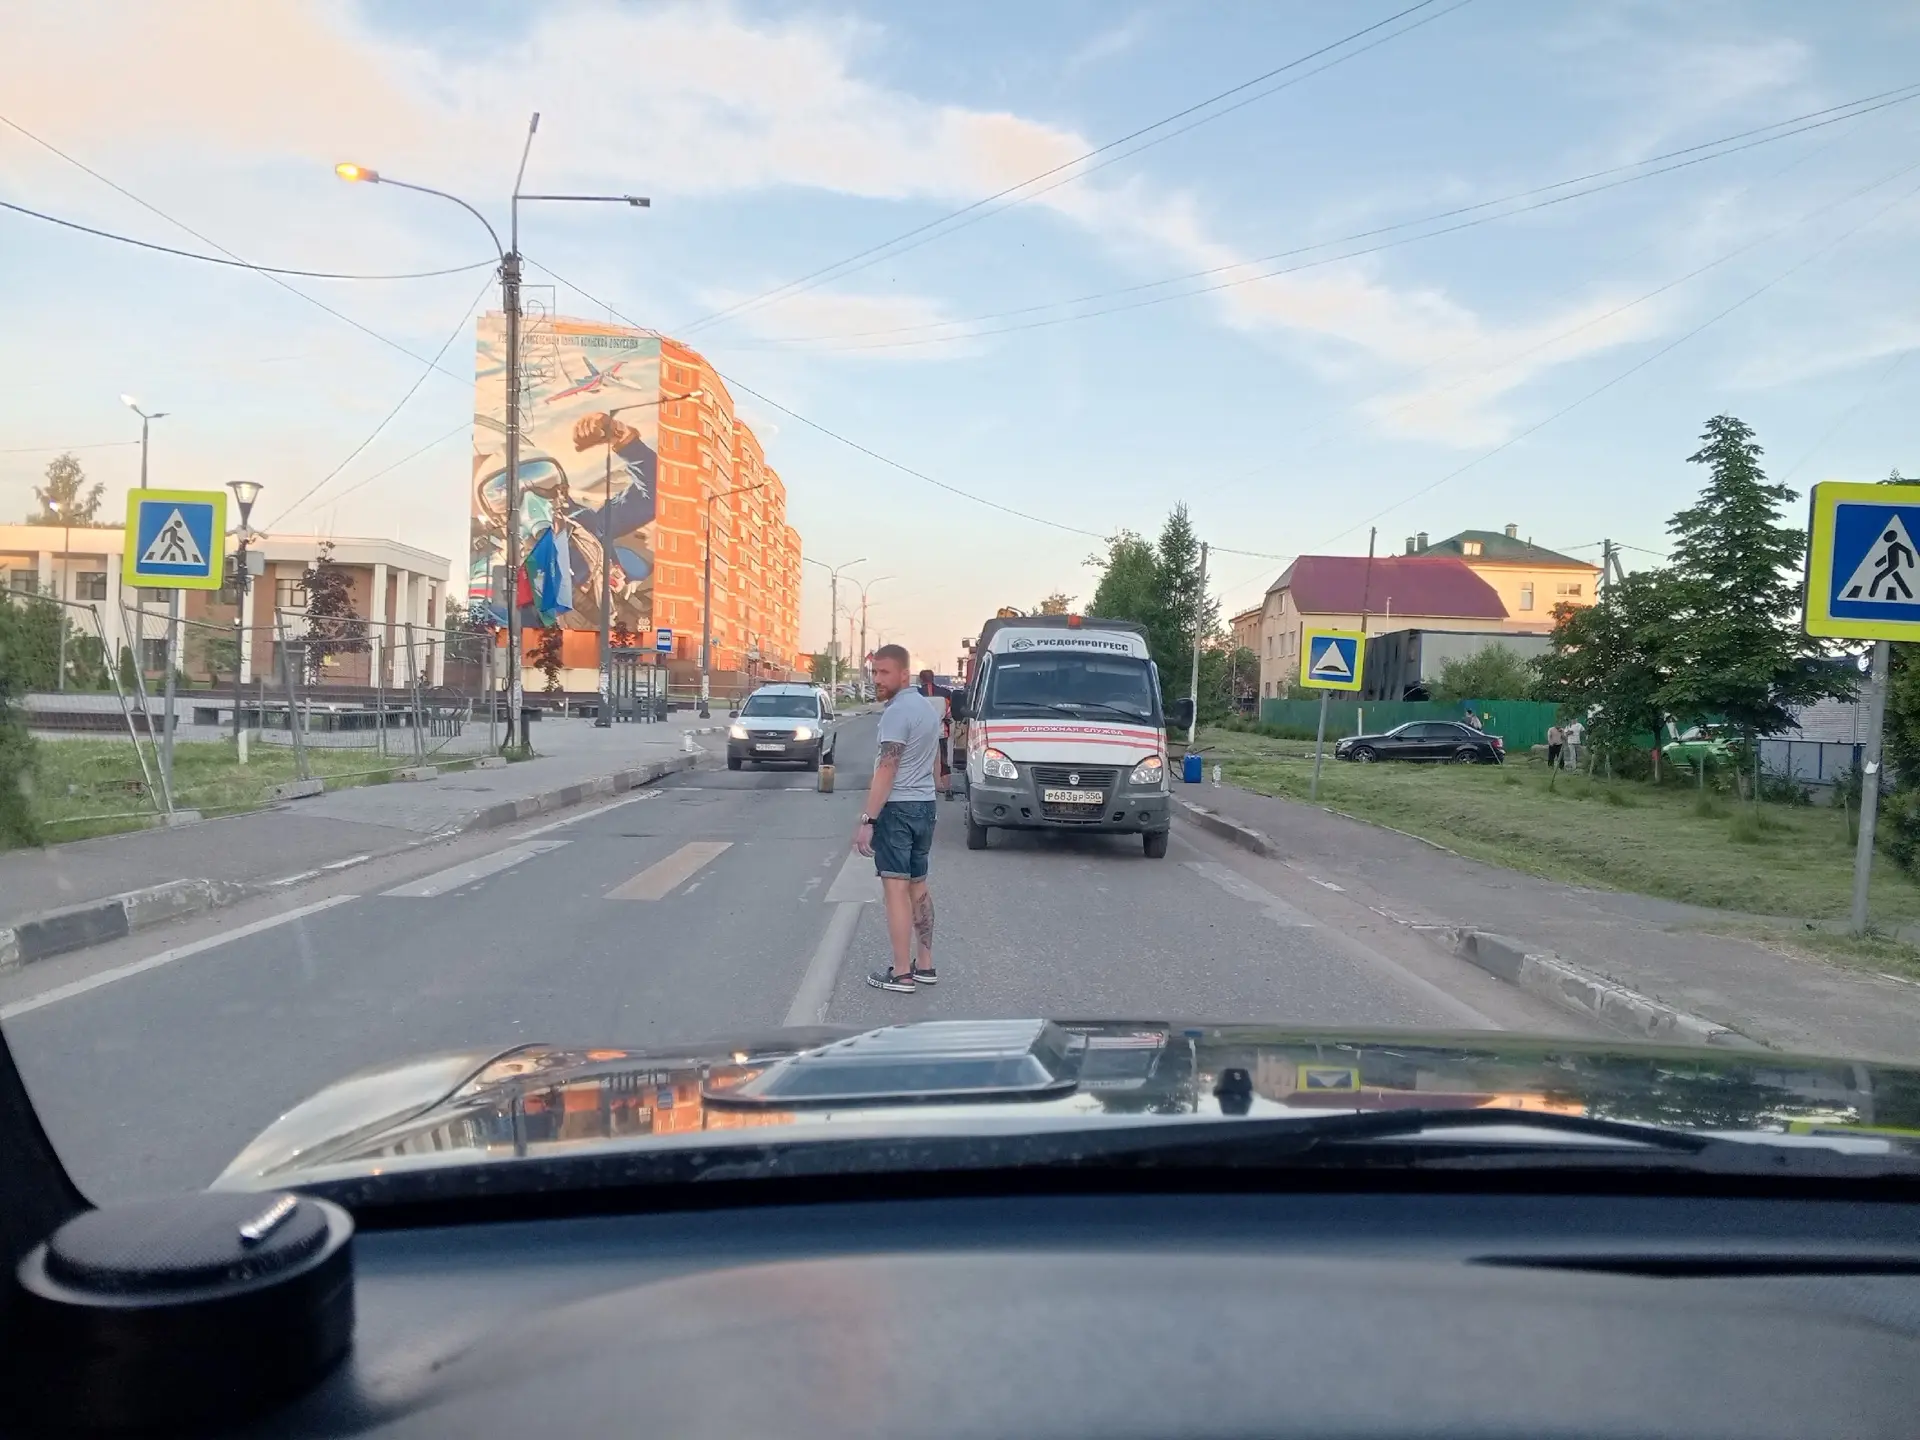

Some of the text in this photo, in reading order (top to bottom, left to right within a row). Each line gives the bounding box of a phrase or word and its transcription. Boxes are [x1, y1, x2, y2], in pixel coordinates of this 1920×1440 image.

[1036, 638, 1129, 652] РУСДОРПРОГРЕСС
[1021, 725, 1124, 736] ДОРОЖНАЯ СЛУЖБА
